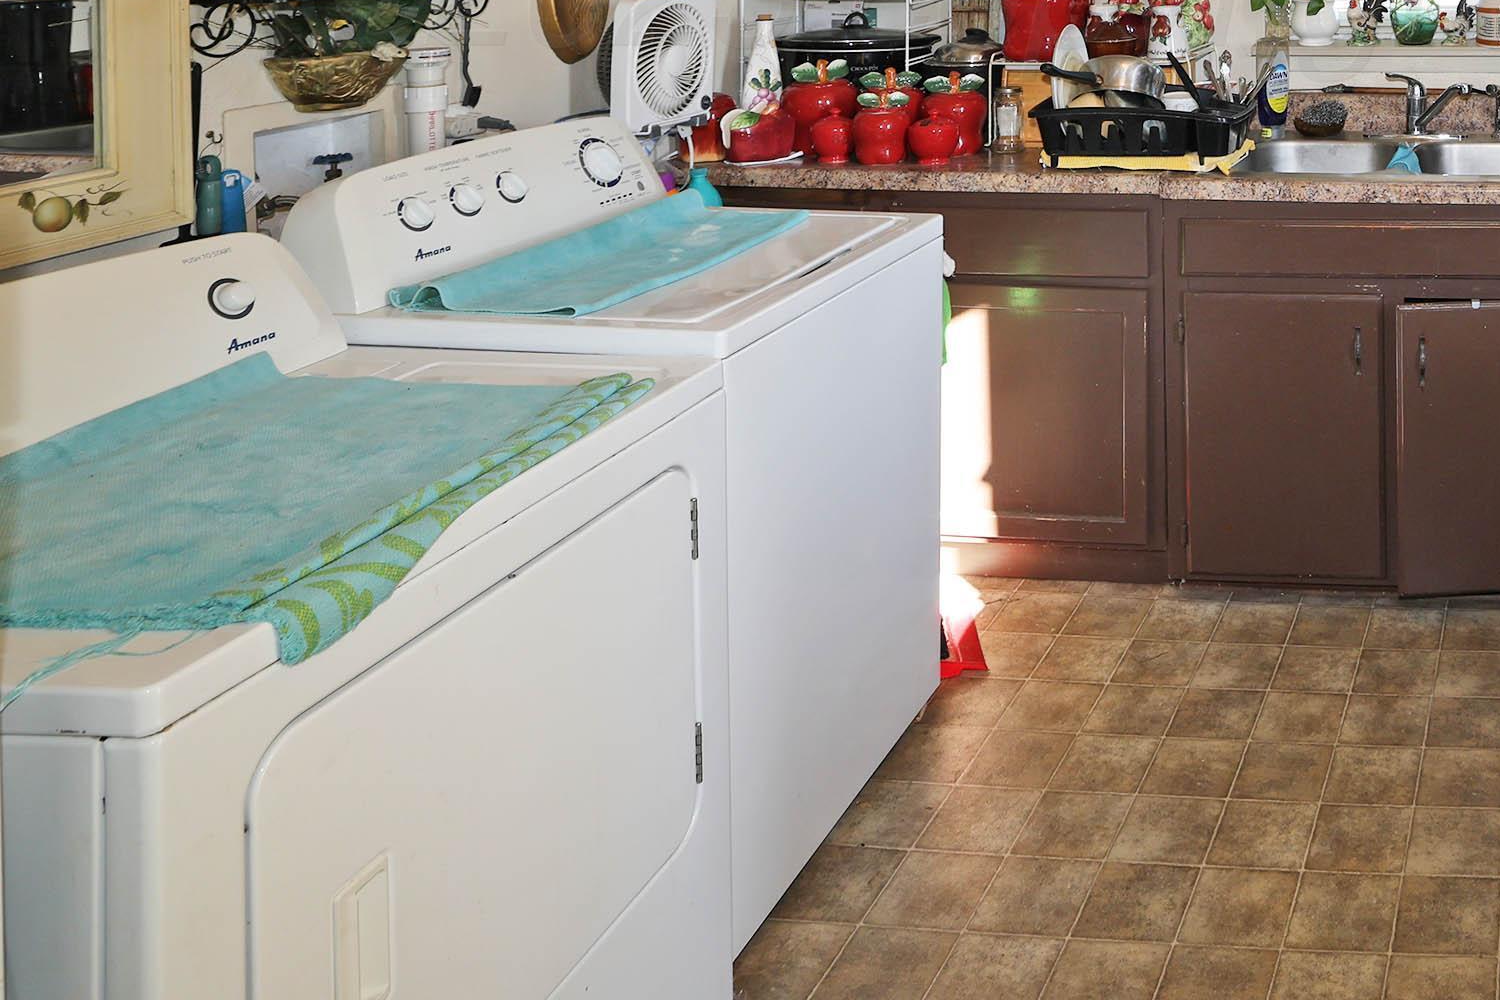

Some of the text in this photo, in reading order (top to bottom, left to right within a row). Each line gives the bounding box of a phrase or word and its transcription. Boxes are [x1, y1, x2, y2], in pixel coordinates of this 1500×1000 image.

[1269, 71, 1288, 81] DAWN
[414, 244, 451, 262] Amana
[226, 331, 276, 354] Amana
